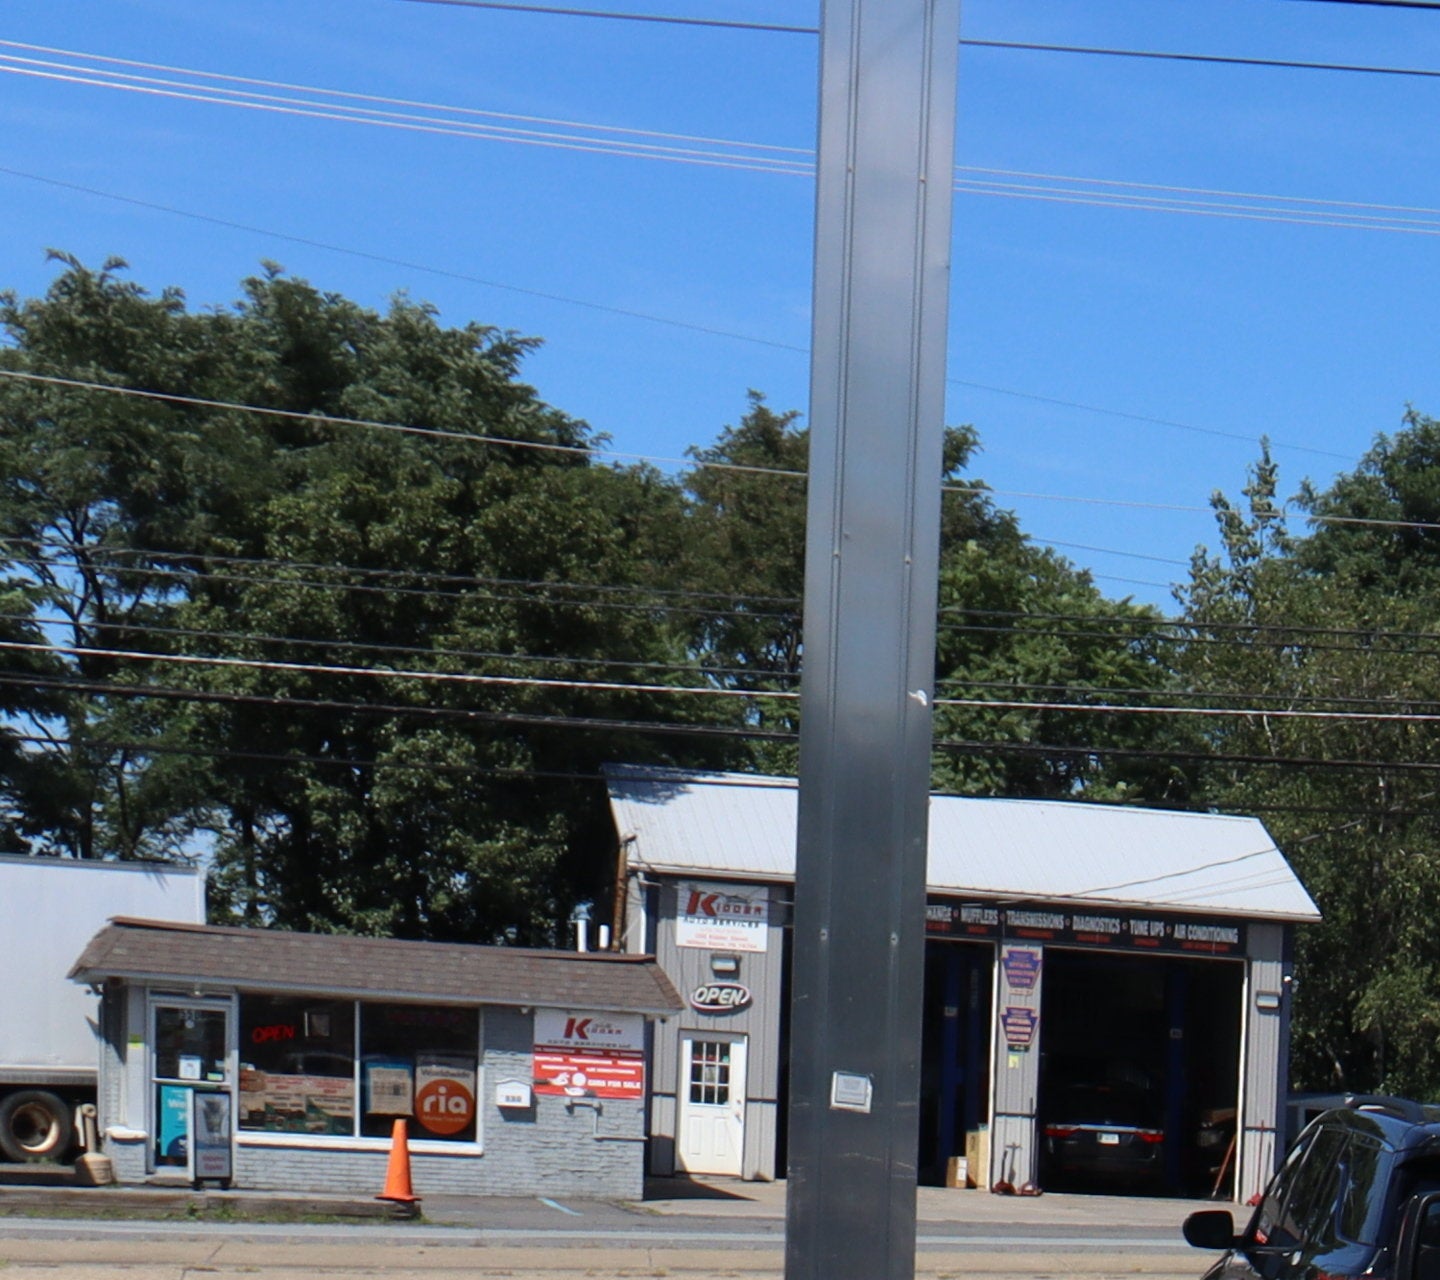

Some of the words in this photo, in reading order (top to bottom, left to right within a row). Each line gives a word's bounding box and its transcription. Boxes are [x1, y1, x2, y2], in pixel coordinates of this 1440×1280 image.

[961, 906, 999, 926] MUFFLERS
[1006, 909, 1064, 930] TRANSMISSIONS
[1072, 914, 1121, 934] DIAGNOSTICS
[1129, 919, 1149, 936] TUNE
[1150, 921, 1165, 937] UPS
[1173, 923, 1187, 940] AIR
[1188, 925, 1239, 944] CONDITIONING
[694, 986, 745, 1006] OPEN
[252, 1025, 296, 1043] OPEN
[423, 1086, 468, 1115] ria
